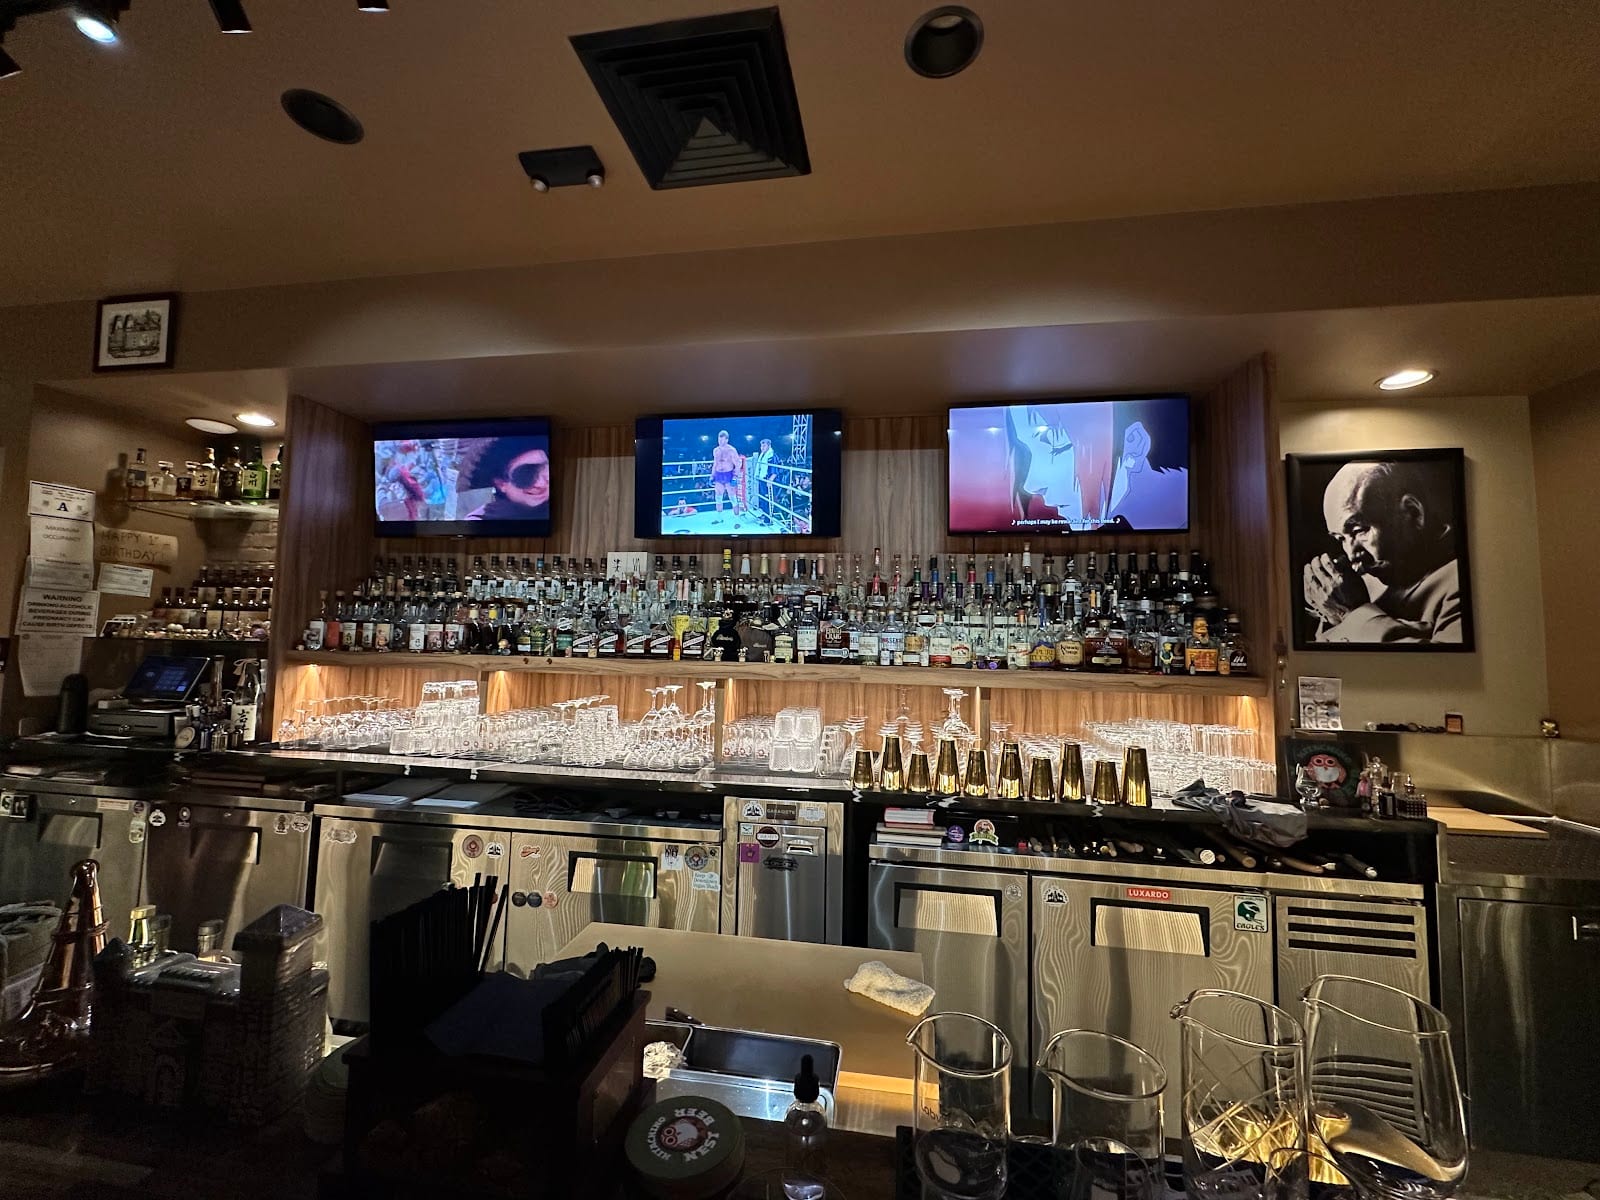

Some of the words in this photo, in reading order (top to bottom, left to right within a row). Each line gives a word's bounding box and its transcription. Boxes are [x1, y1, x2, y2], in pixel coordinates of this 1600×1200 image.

[56, 501, 69, 512] A
[100, 544, 157, 561] BIRTHDAY
[42, 594, 82, 603] WARNING
[1128, 888, 1169, 899] LUXARDO
[1236, 922, 1265, 931] EAGLES
[674, 1108, 715, 1126] BEER
[647, 1116, 672, 1160] HITACHINO
[683, 1131, 720, 1161] NEST
